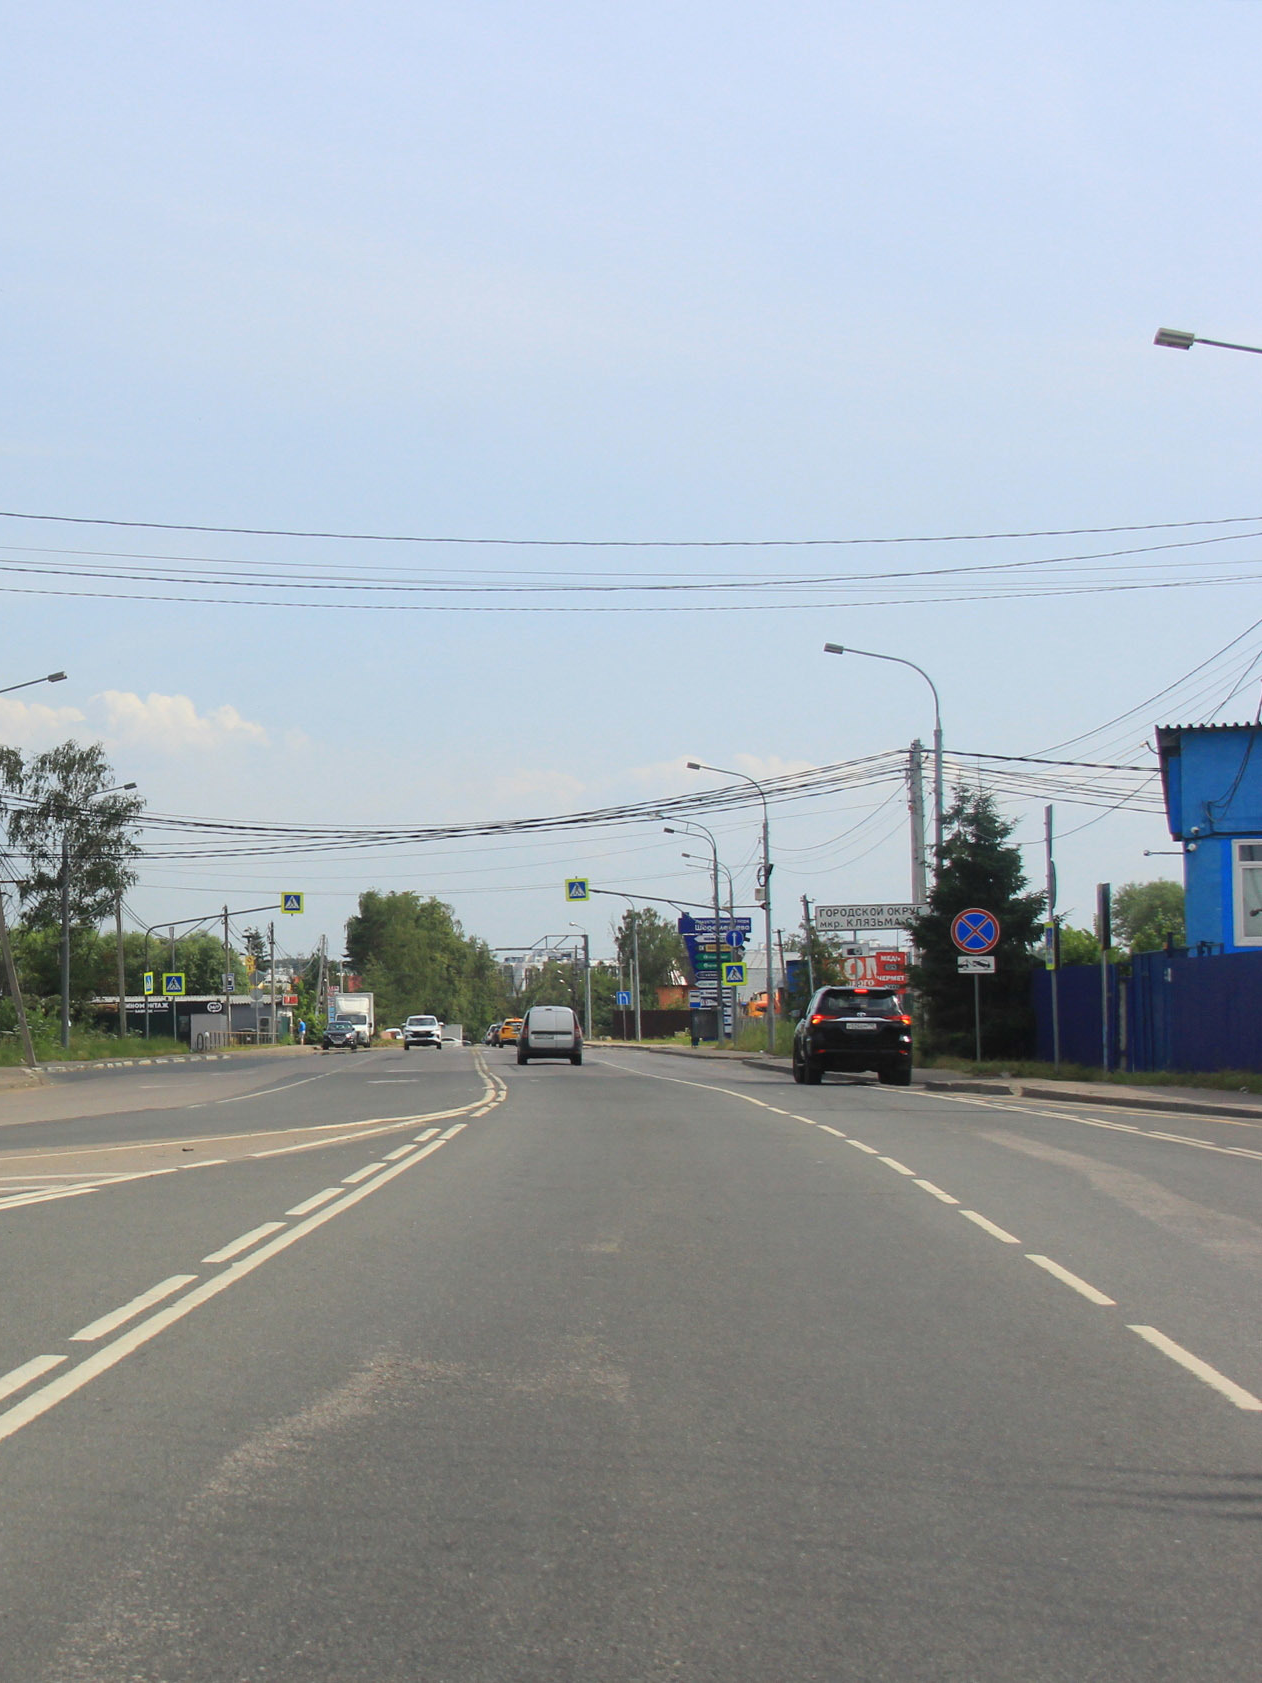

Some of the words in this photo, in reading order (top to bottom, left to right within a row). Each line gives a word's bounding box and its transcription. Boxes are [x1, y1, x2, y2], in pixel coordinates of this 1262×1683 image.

[819, 908, 884, 918] ГОРОДСКОЙ
[887, 906, 923, 917] ОКРУГ
[819, 921, 844, 930] мкр.
